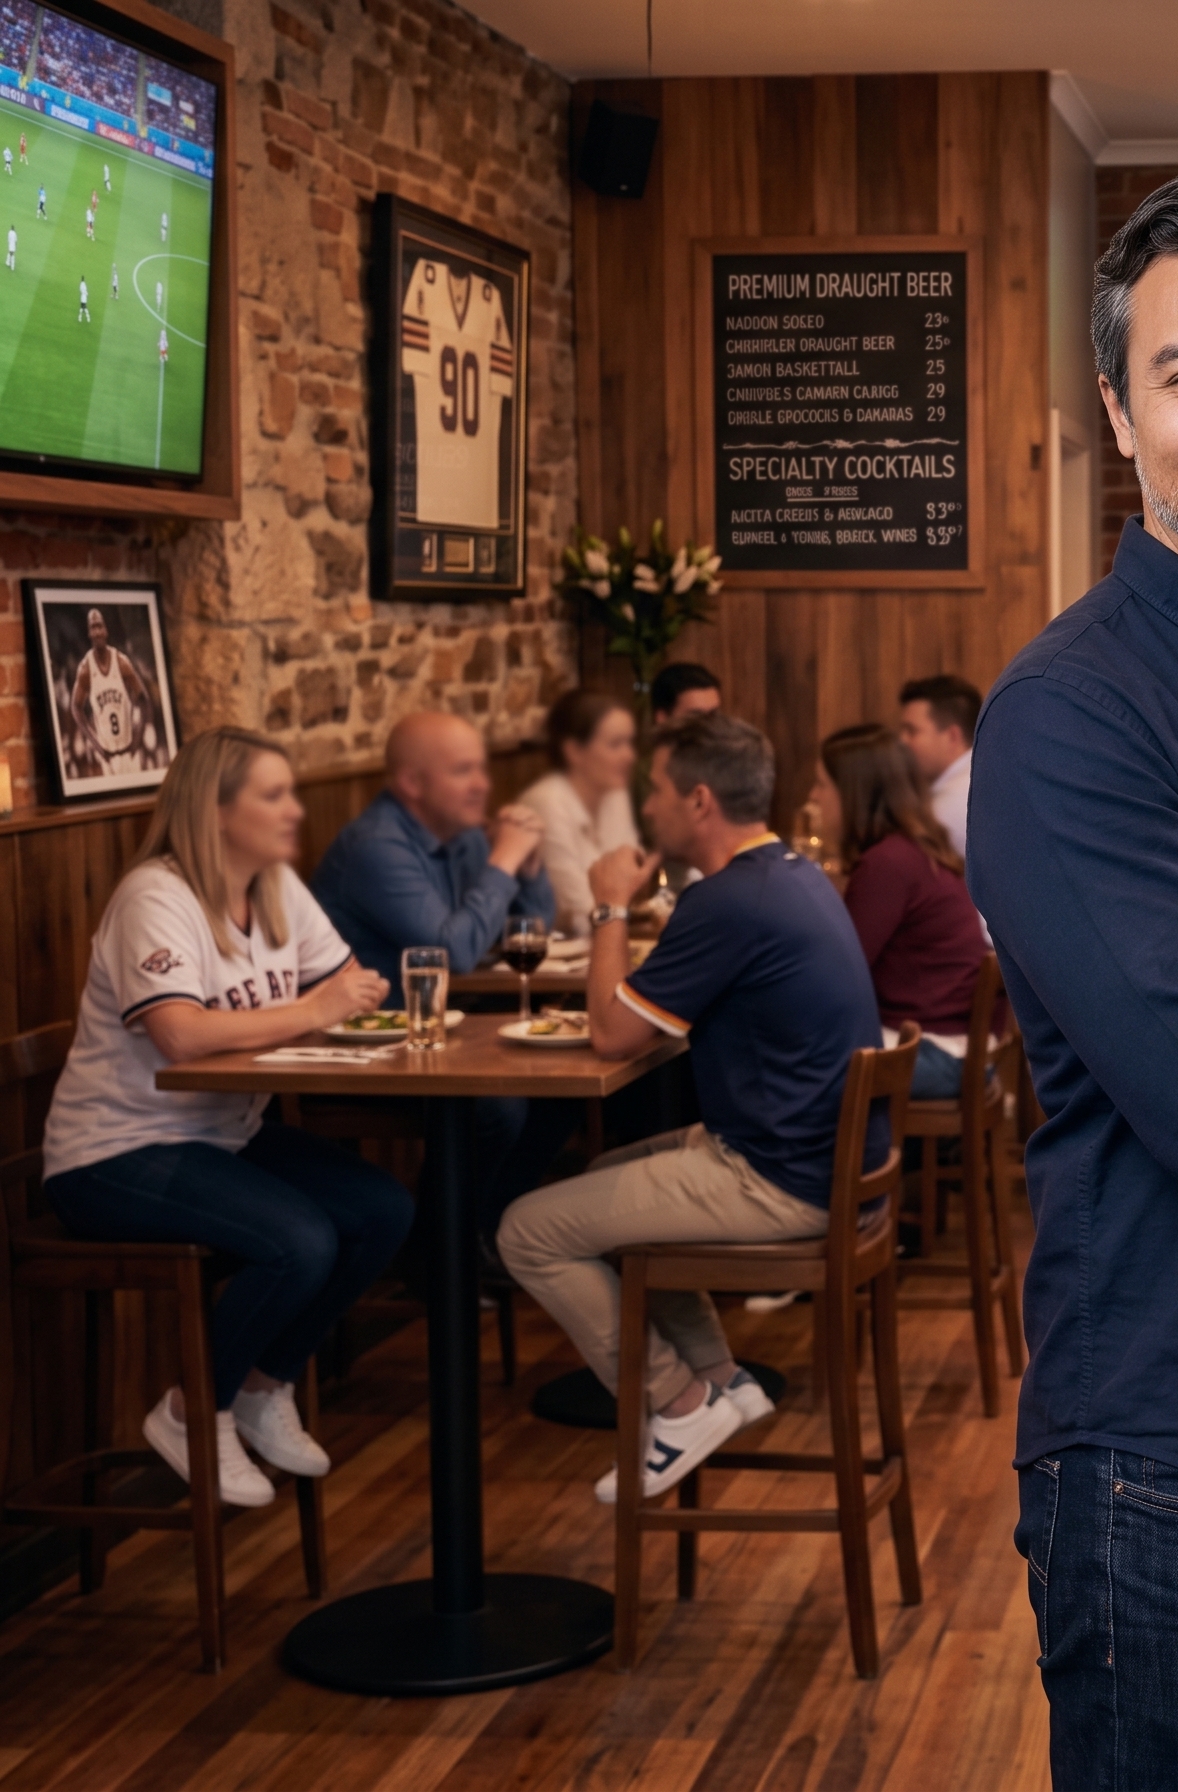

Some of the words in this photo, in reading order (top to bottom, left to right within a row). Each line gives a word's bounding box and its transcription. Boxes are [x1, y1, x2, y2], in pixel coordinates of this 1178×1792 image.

[729, 274, 809, 299] PREMIUM
[817, 273, 901, 297] DRAUGHT
[907, 272, 952, 296] BEER
[863, 336, 894, 350] BEER
[776, 361, 860, 377] BASKETTALL
[926, 360, 945, 374] 25
[440, 345, 479, 437] 90
[927, 383, 945, 398] 29
[928, 406, 945, 421] 29
[730, 457, 837, 480] SPECIALTY
[845, 455, 955, 479] COCKTAILS
